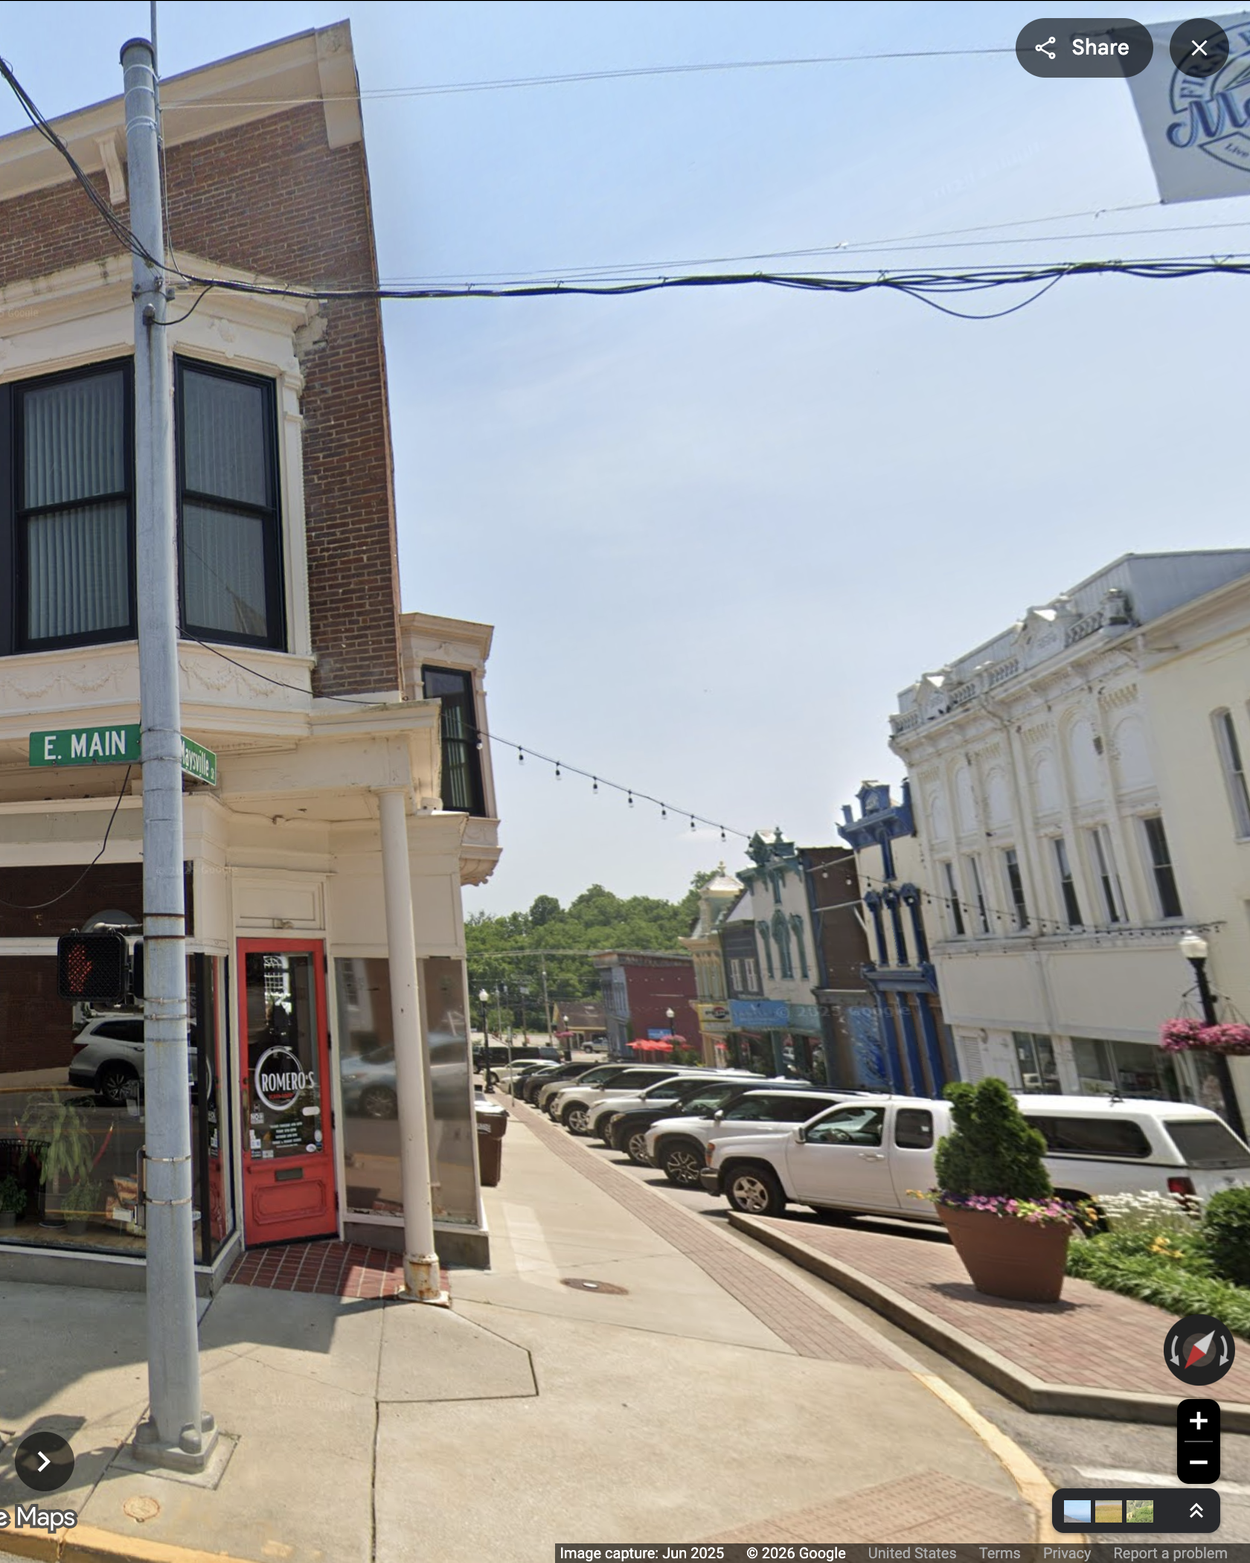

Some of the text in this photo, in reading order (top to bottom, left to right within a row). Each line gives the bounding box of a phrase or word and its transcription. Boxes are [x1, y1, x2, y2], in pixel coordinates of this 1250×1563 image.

[44, 730, 126, 760] E. MAIN
[261, 1071, 315, 1092] ROMERO'S
